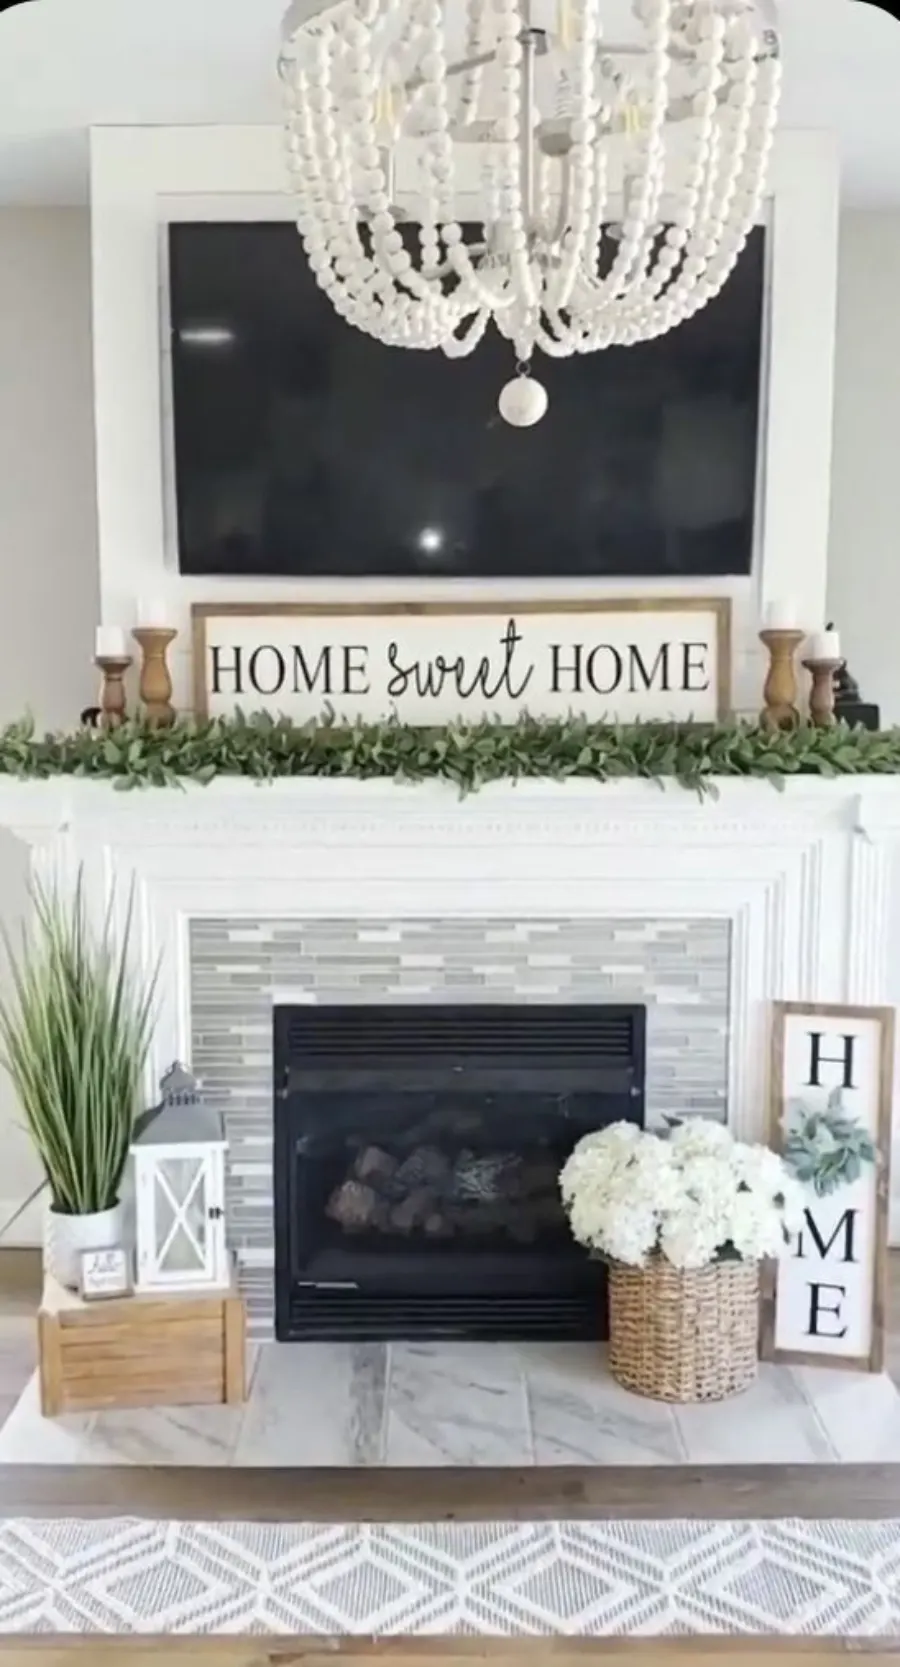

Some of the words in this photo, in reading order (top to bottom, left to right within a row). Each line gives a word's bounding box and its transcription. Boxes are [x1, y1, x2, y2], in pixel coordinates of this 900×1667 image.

[209, 645, 370, 694] HOME
[386, 617, 535, 699] sweet
[550, 642, 710, 694] HOME
